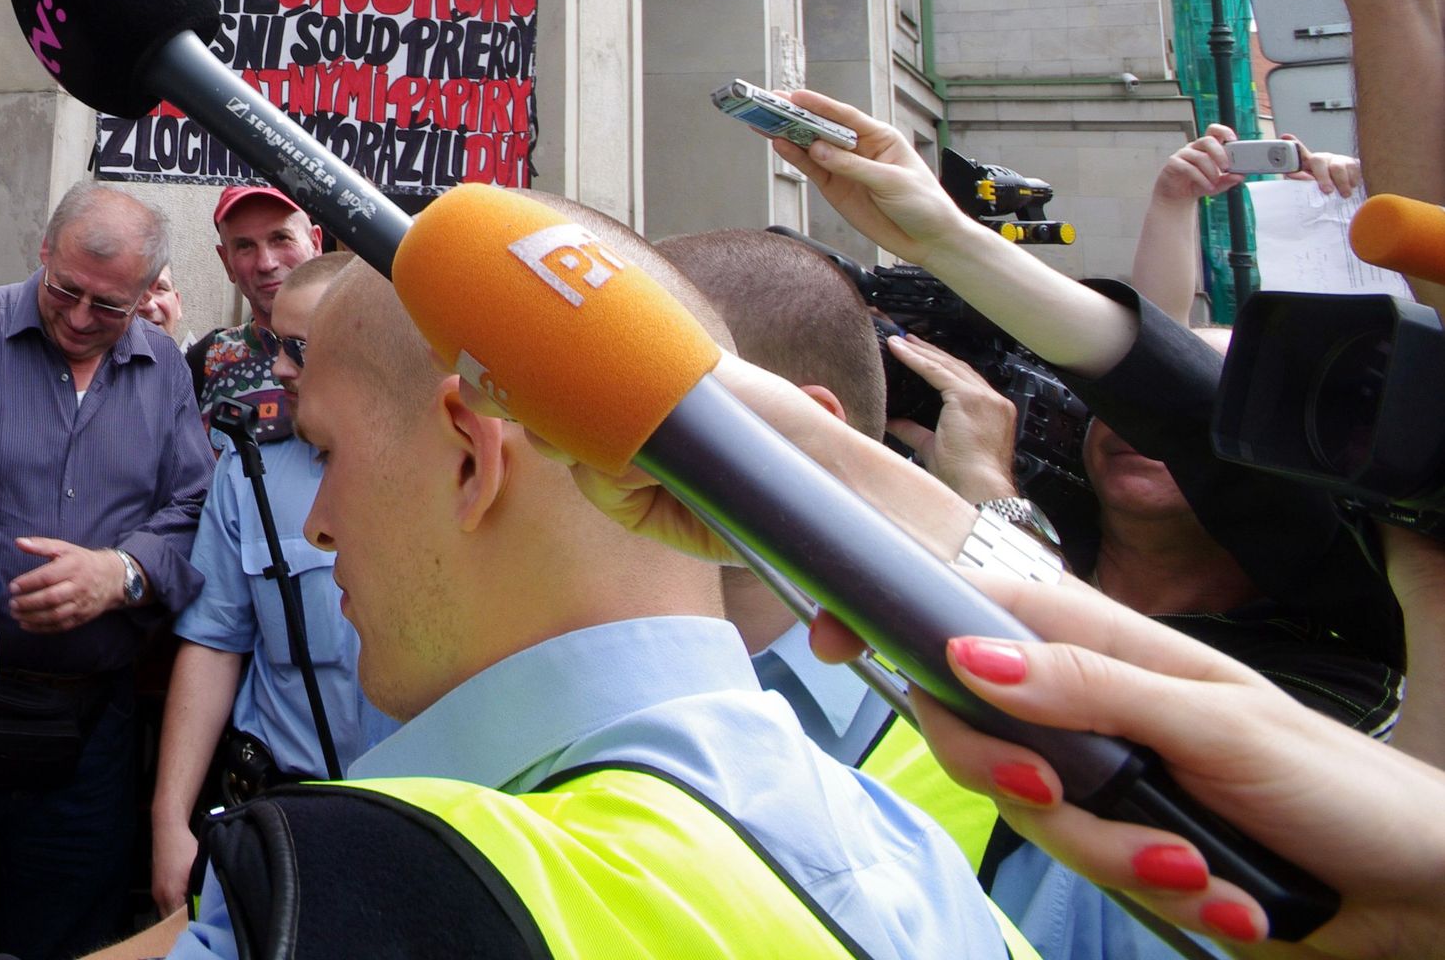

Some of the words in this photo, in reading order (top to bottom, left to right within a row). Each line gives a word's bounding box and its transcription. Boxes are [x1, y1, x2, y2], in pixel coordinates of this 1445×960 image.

[290, 11, 400, 66] SOUD
[387, 75, 532, 133] PAPÍRY
[245, 113, 337, 188] SENNHEISER
